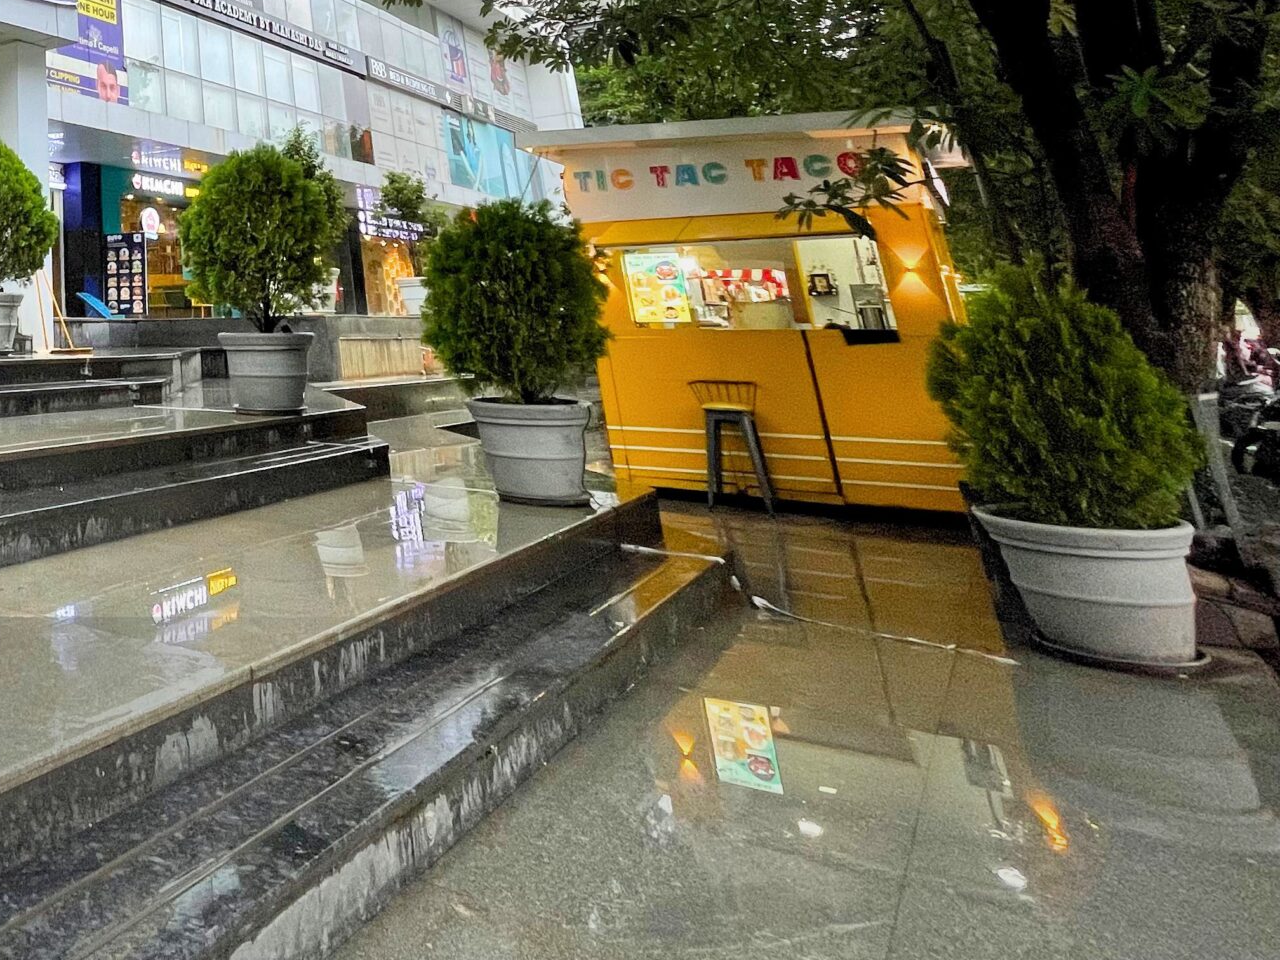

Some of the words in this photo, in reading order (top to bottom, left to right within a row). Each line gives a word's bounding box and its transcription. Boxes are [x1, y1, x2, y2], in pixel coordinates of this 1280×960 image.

[77, 1, 91, 14] NE
[92, 6, 115, 21] HOUR
[215, 0, 258, 27] ACADEMY
[259, 16, 270, 31] BY
[271, 20, 308, 47] MANASHI
[308, 37, 323, 53] DAS
[98, 41, 119, 55] Capelli
[49, 70, 80, 85] CLIPPING
[573, 168, 634, 192] TIC
[649, 161, 728, 188] TAC
[744, 151, 864, 182] TACO
[141, 175, 184, 197] KIMCHI
